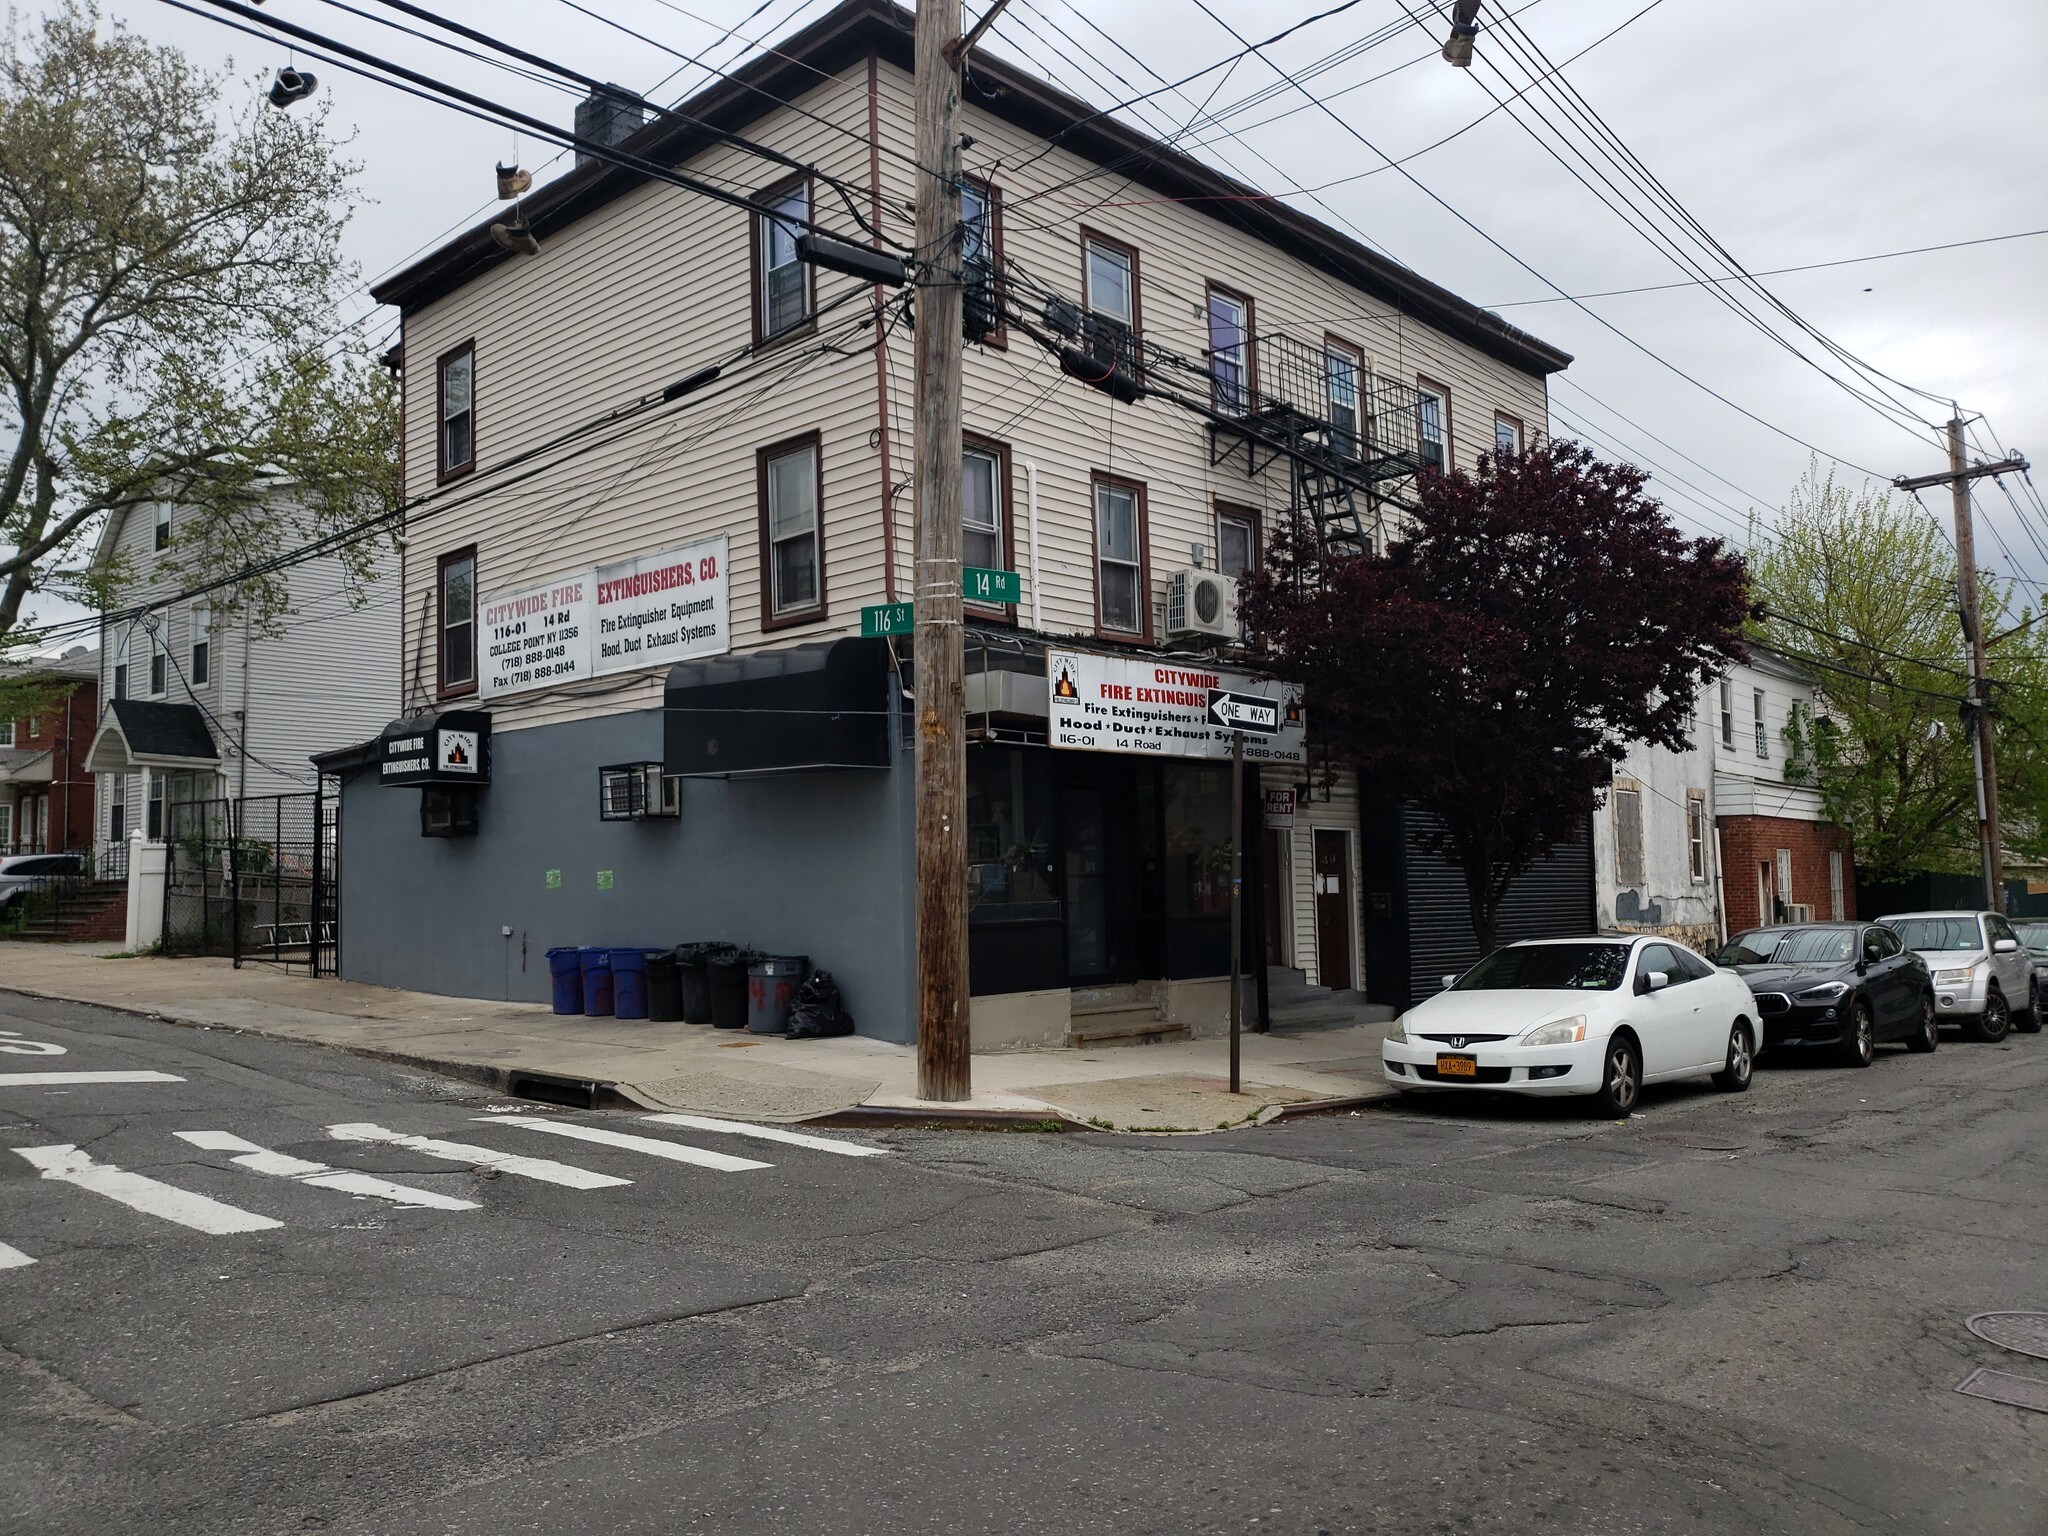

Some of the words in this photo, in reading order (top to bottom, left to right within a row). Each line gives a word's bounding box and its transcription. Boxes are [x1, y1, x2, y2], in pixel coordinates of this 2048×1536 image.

[486, 592, 548, 626] CITYWIDE
[552, 583, 583, 608] FIRE
[597, 561, 696, 605] EXTINGUISHERS,
[700, 556, 719, 582] CO.
[976, 573, 990, 596] 14
[996, 575, 1006, 590] Rd
[494, 621, 527, 640] 116-01
[543, 614, 555, 628] 14
[557, 609, 570, 624] Rd
[600, 618, 616, 634] Fire
[617, 607, 667, 629] Extinguisher
[671, 595, 714, 620] Equipment
[874, 609, 892, 632] 116
[896, 608, 905, 622] St
[489, 640, 521, 657] COLLEGE
[523, 635, 545, 650] POINT
[547, 631, 557, 644] NY
[558, 626, 579, 641] 11356
[624, 637, 642, 653] Duct
[646, 630, 679, 649] Exhaust
[681, 623, 716, 645] Systems
[501, 655, 523, 671] (718)
[525, 645, 565, 665] 888-0148
[493, 676, 509, 687] Fax
[510, 670, 532, 685] (718)
[534, 660, 575, 679] 888-0144
[1154, 669, 1220, 689] CITYWIDE
[1100, 684, 1133, 701] FIRE
[1136, 687, 1206, 708] EXTINGUIS
[1084, 702, 1108, 715] Fire
[1112, 705, 1191, 723] Extinguishers
[1221, 702, 1240, 718] ONE
[1250, 706, 1271, 723] WAY
[444, 733, 456, 747] CITY
[458, 733, 473, 749] WIDE
[1060, 717, 1102, 731] Hood
[1112, 722, 1146, 734] Duct
[1155, 726, 1210, 740] Exhaust
[1214, 730, 1268, 745] Sysems
[1060, 734, 1095, 746] 116-01
[1116, 738, 1129, 748] 14
[1134, 738, 1161, 750] Road
[388, 740, 413, 754] CITYWIDE
[413, 737, 424, 750] FIRE
[1223, 746, 1300, 761] 71-888-0148
[382, 758, 421, 775] EXTINGUISHERS,
[421, 757, 430, 771] CO.
[1266, 802, 1293, 813] RENT
[1269, 791, 1290, 802] FOR
